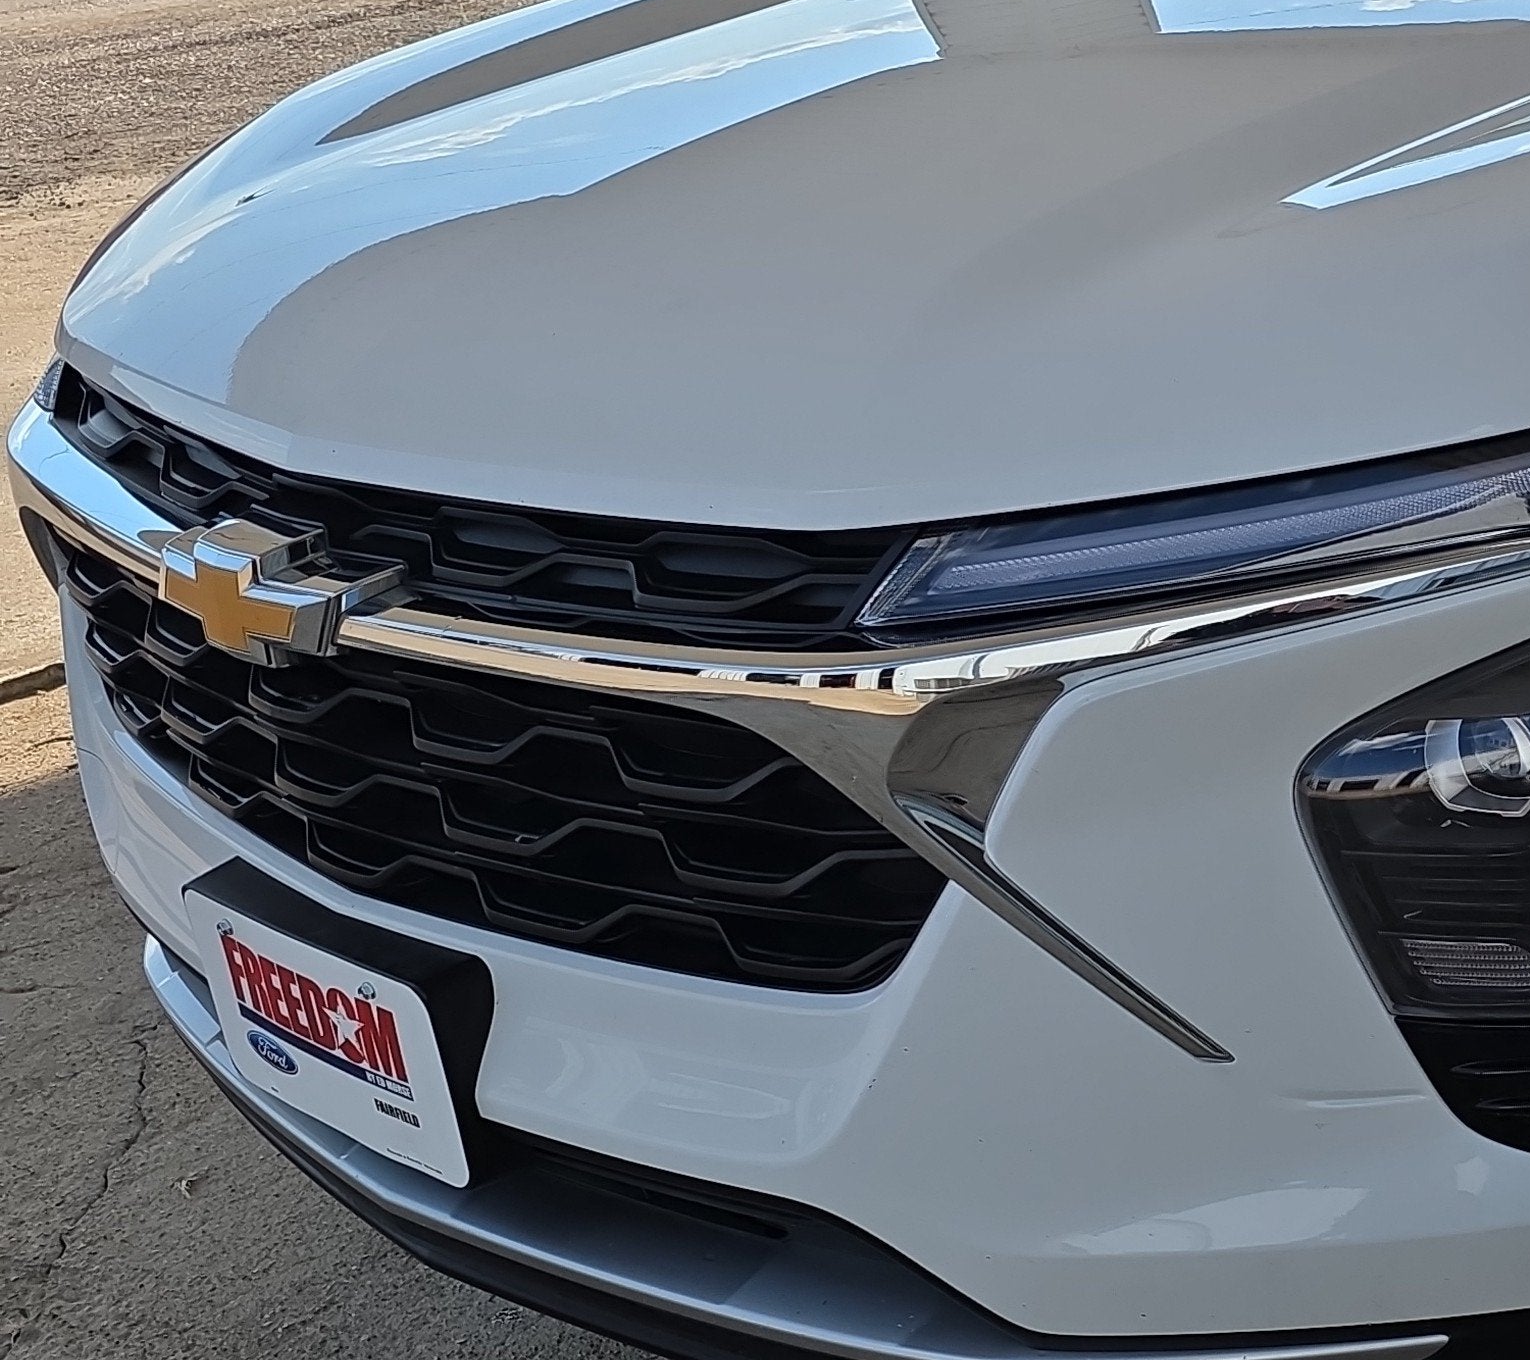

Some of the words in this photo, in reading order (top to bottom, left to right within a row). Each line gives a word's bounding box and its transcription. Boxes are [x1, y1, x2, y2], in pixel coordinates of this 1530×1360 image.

[221, 933, 409, 1083] FREEDOM
[257, 1036, 289, 1070] Ford
[373, 1097, 421, 1128] FAIRFIELD
